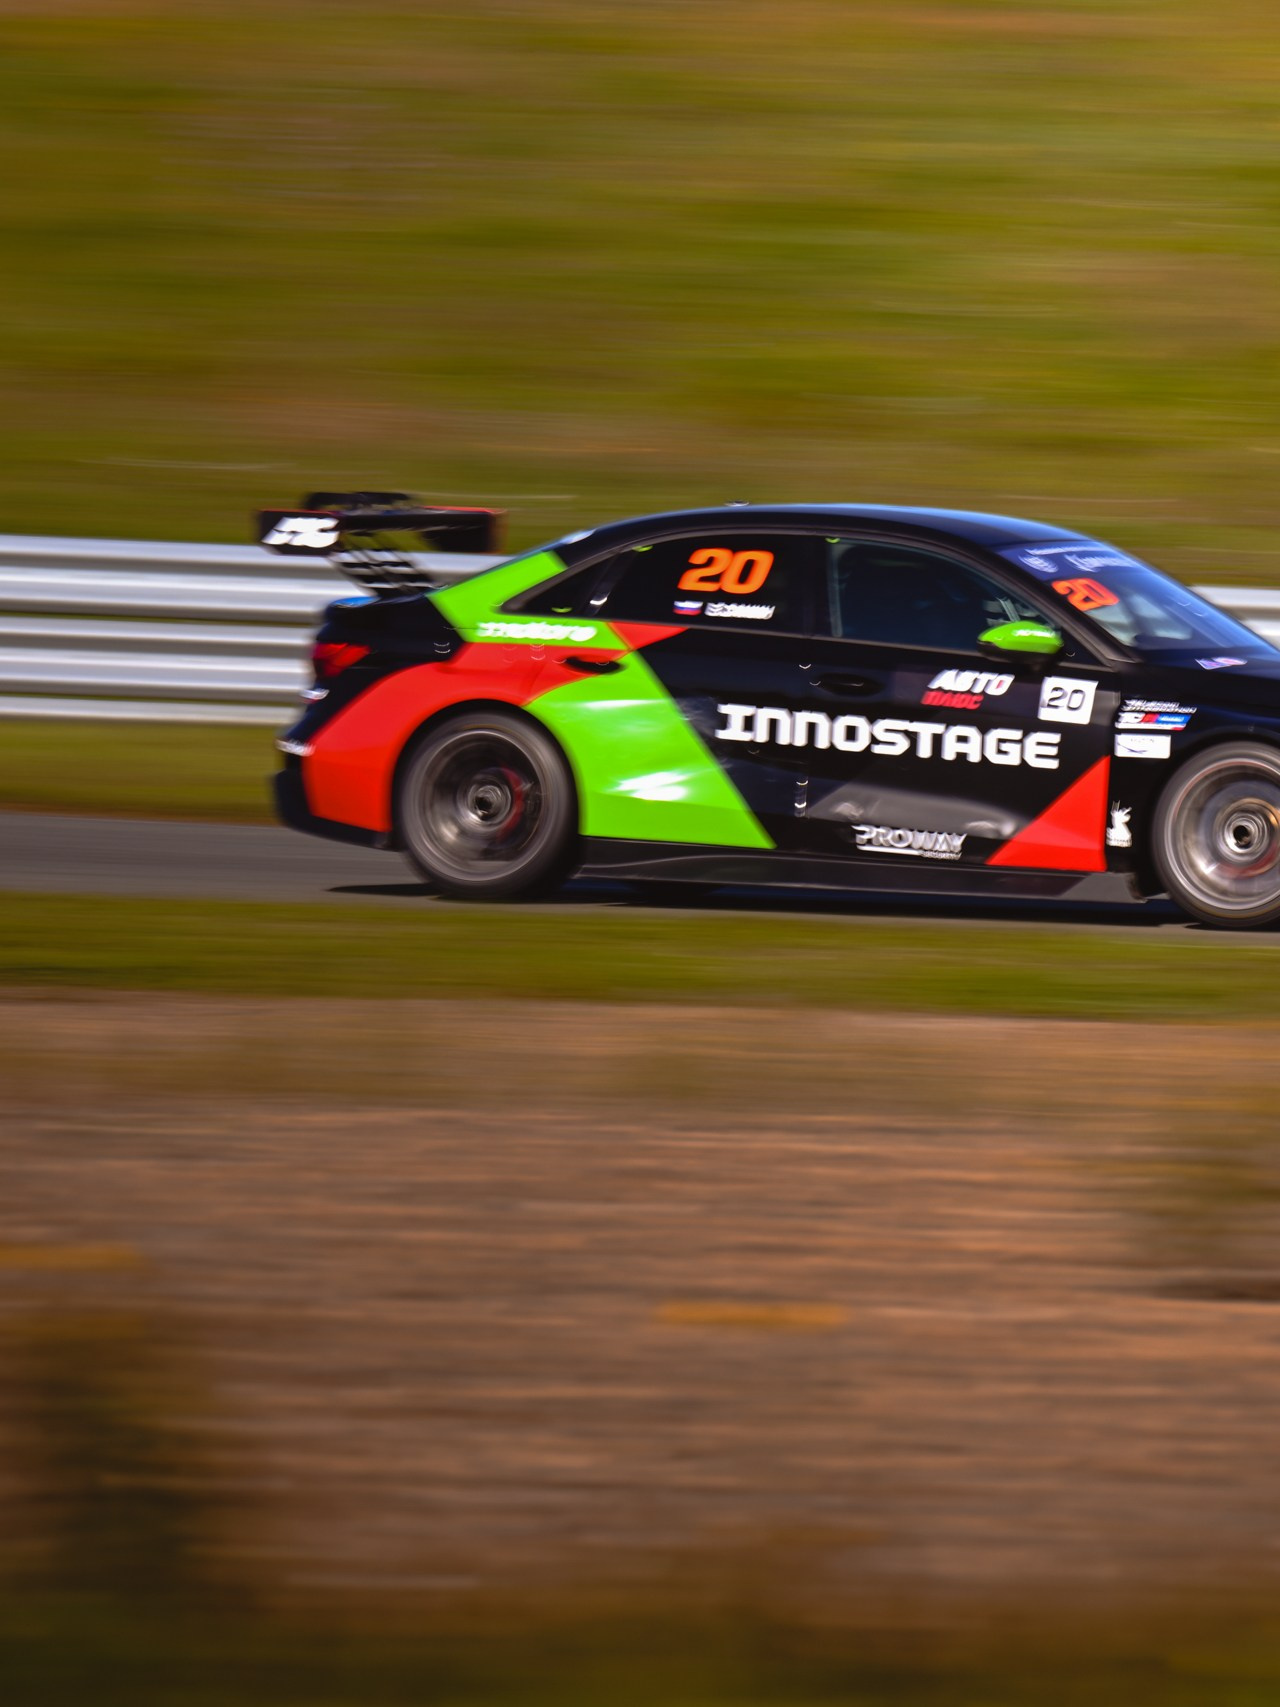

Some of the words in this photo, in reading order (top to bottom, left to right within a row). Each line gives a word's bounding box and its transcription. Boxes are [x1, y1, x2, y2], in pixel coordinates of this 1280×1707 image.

[677, 547, 775, 594] 20
[1051, 578, 1120, 612] 20
[927, 668, 1015, 696] АВТО
[1046, 686, 1086, 711] 20
[714, 703, 1063, 770] INNOSTAGE
